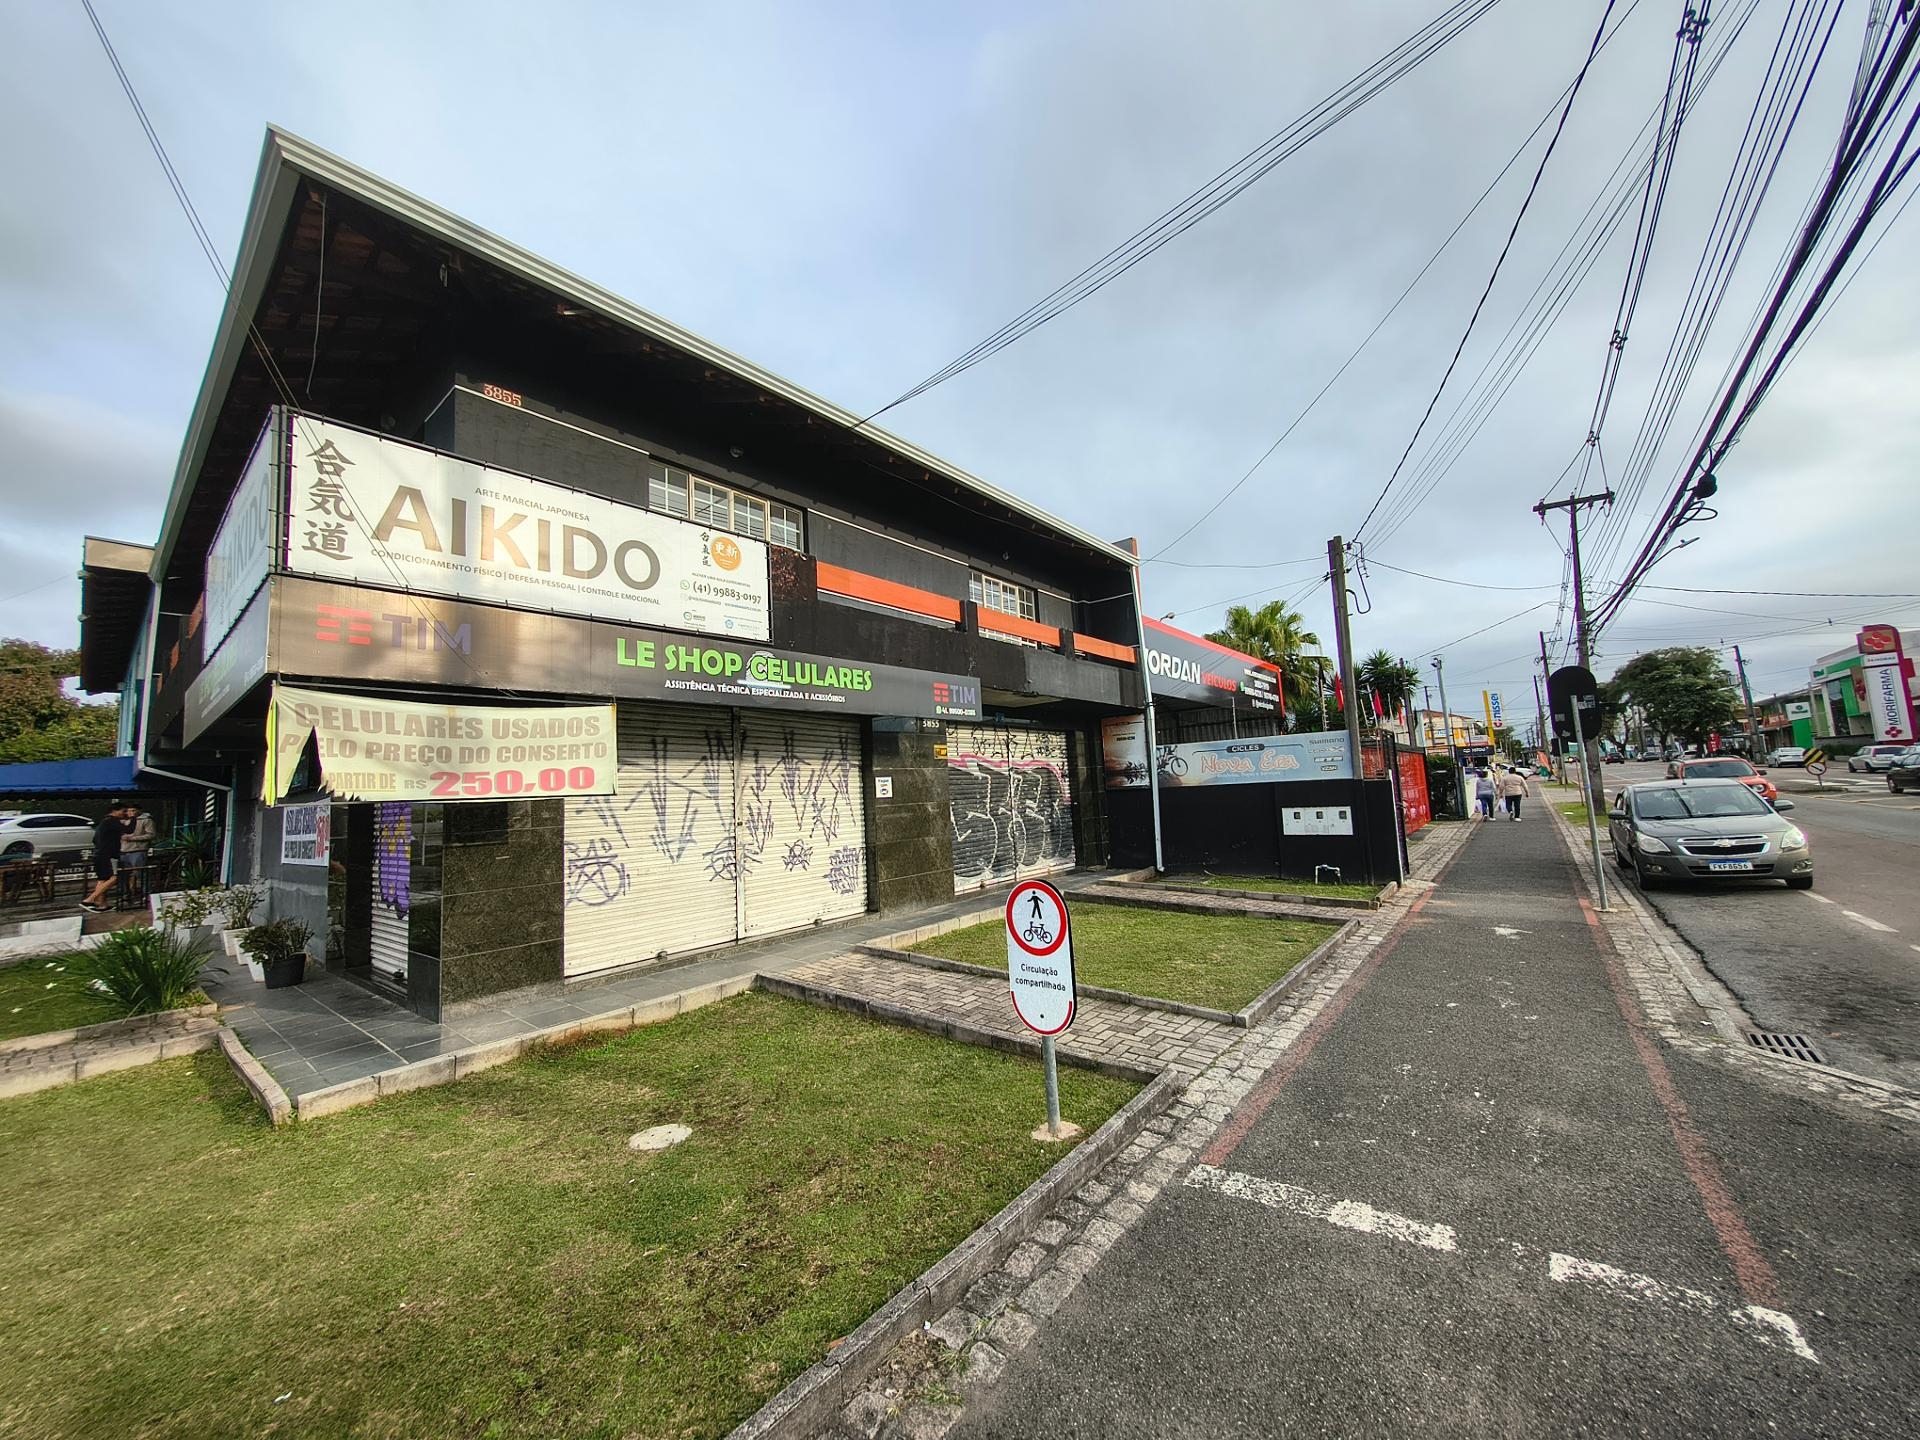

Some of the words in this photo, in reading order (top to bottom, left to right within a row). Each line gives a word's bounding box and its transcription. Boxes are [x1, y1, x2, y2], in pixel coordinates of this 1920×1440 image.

[484, 383, 522, 407] 3855
[301, 438, 357, 561] 合気道
[475, 487, 501, 500] ARTE
[502, 494, 544, 511] MARCIAL
[546, 505, 590, 522] JAPONESA
[370, 485, 661, 591] AIKIDO
[370, 548, 472, 573] CONDICIONAMENTO
[473, 566, 502, 578] FÍSICO
[508, 573, 540, 586] DEFESA
[541, 578, 577, 593] PESSOAL
[581, 586, 621, 599] CONTROLE
[620, 592, 662, 605] EMOCIONAL
[692, 580, 711, 595] (41)
[712, 586, 762, 604] 99883-0197
[381, 613, 472, 656] TIM
[616, 637, 656, 669] LE
[664, 644, 743, 678] SHOP
[749, 655, 873, 692] CELULARES
[664, 679, 716, 693] ASSISTÊNCIA
[716, 683, 751, 696] TÉCNICA
[751, 686, 804, 700] ESPECIALIZADA
[804, 692, 810, 700] E
[949, 684, 976, 705] TIM
[1880, 668, 1900, 726] MORIFARMA
[294, 702, 484, 740] CELULARES
[491, 715, 601, 740] USADOS
[922, 719, 940, 728] 3855
[365, 741, 453, 767] PREÇO
[459, 746, 491, 764] DO
[496, 742, 608, 763] CONSERTO
[1200, 752, 1256, 774] Nova
[1258, 749, 1300, 770] Era
[327, 772, 376, 791] PARTIR
[379, 774, 396, 790] DE
[429, 766, 596, 796] 250,00
[1015, 976, 1066, 992] compartilhada
[1020, 963, 1058, 977] Circulação
